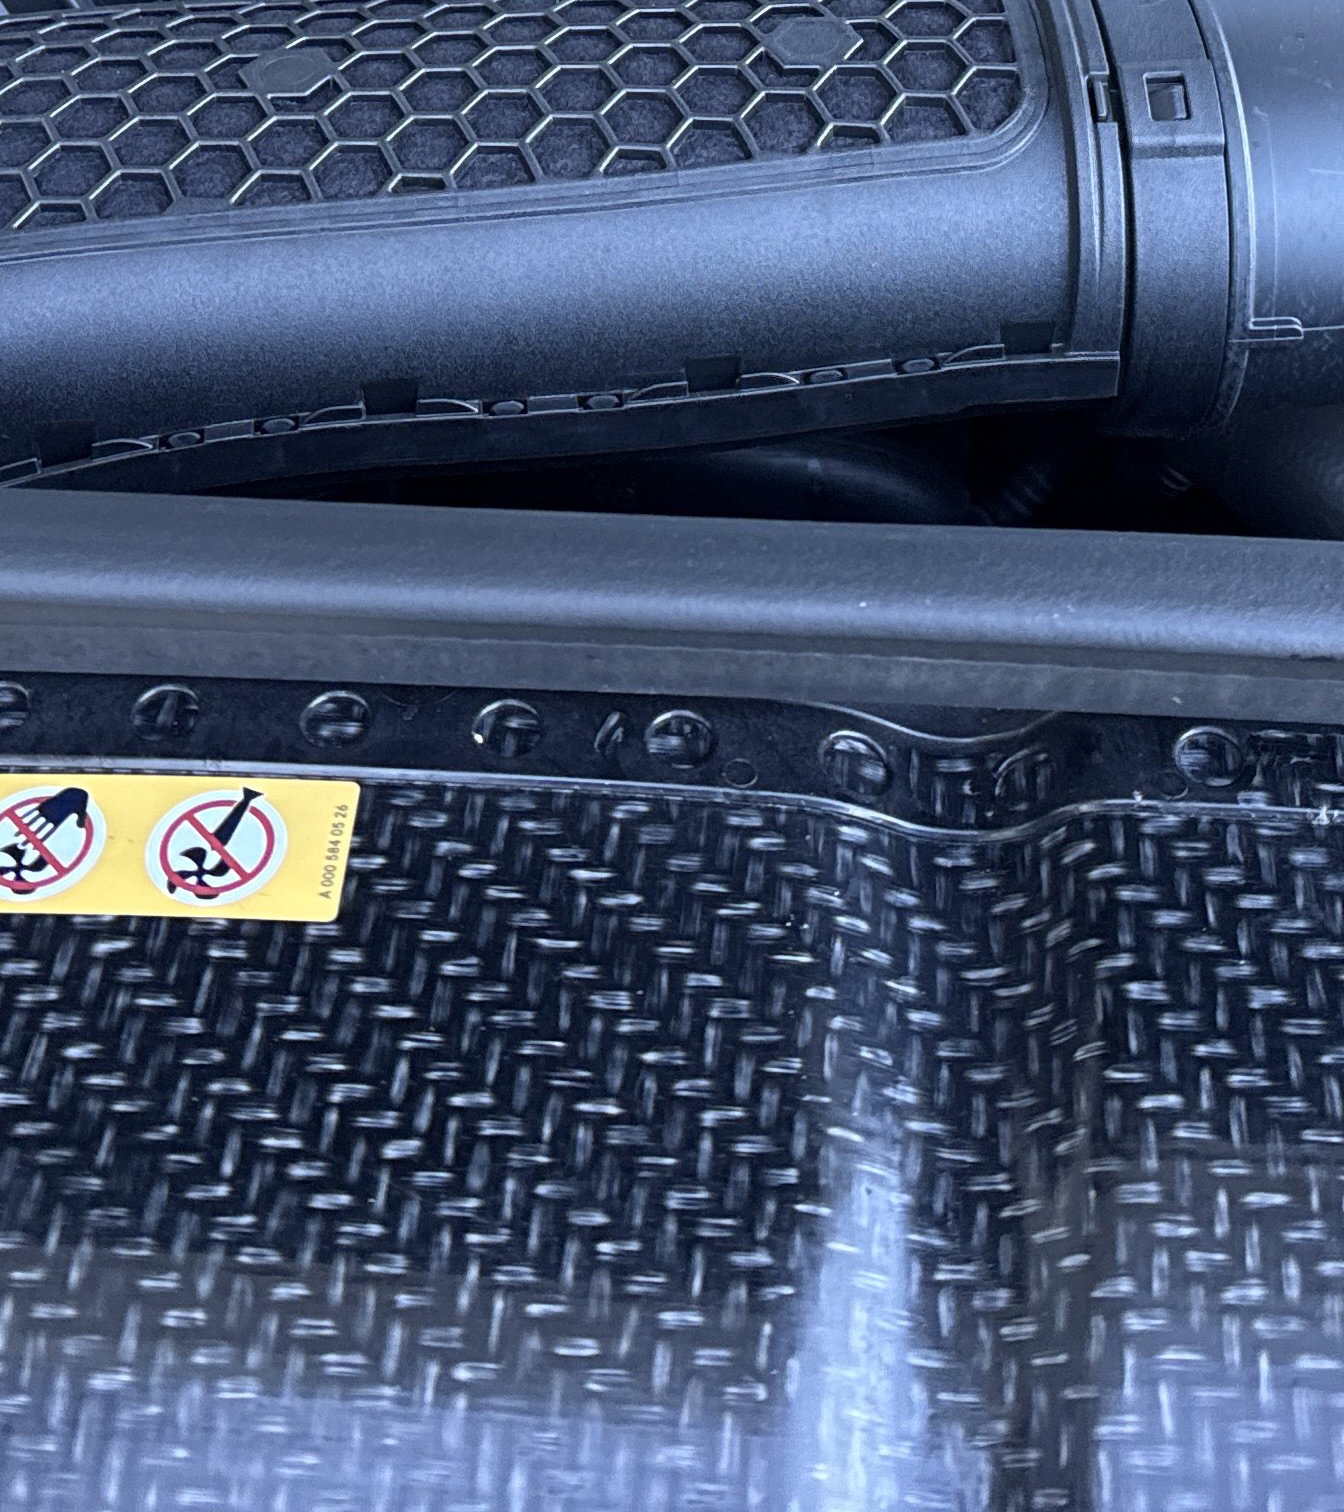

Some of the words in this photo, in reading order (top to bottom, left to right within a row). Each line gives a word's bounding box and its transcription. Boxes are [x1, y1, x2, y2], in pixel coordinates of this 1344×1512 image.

[334, 804, 349, 818] 26
[330, 822, 346, 836] 05
[325, 840, 341, 861] 584
[320, 864, 337, 887] 000
[318, 890, 332, 899] A
